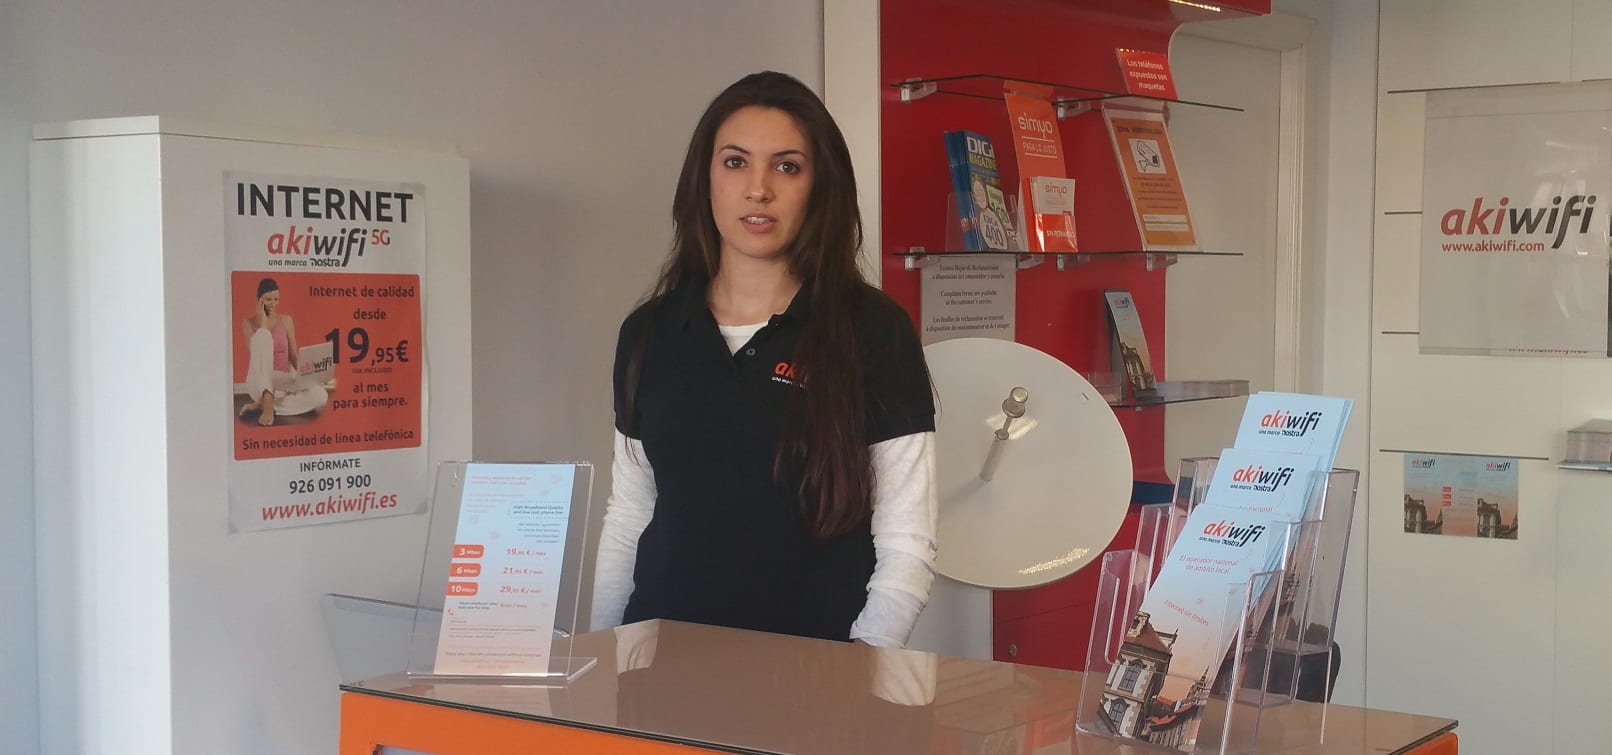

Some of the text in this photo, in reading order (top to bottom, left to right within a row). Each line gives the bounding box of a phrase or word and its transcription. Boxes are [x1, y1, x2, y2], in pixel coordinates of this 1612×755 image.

[1130, 72, 1157, 80] expuestos
[1018, 112, 1053, 138] simyo
[1046, 183, 1068, 197] simyo
[237, 182, 414, 222] INTERNET
[1440, 196, 1597, 249] akiwifi
[267, 226, 390, 267] akiwifi 5G
[1442, 240, 1544, 253] www.akiwifi.com
[309, 286, 415, 297] Internet de calidad
[353, 309, 387, 320] desde
[325, 327, 409, 366] 19,95€
[353, 381, 389, 393] al mes
[333, 396, 408, 410] para siempre.
[1261, 410, 1322, 437] akiwifi
[243, 429, 414, 450] Sin necesidad de línea telefónica
[300, 458, 361, 472] INFÓRMATE
[289, 474, 371, 494] 926 091 900
[1232, 465, 1294, 492] akiwifi
[262, 492, 398, 521] www.akiwifi.es
[1203, 520, 1266, 547] akiwifi
[460, 548, 466, 556] 3
